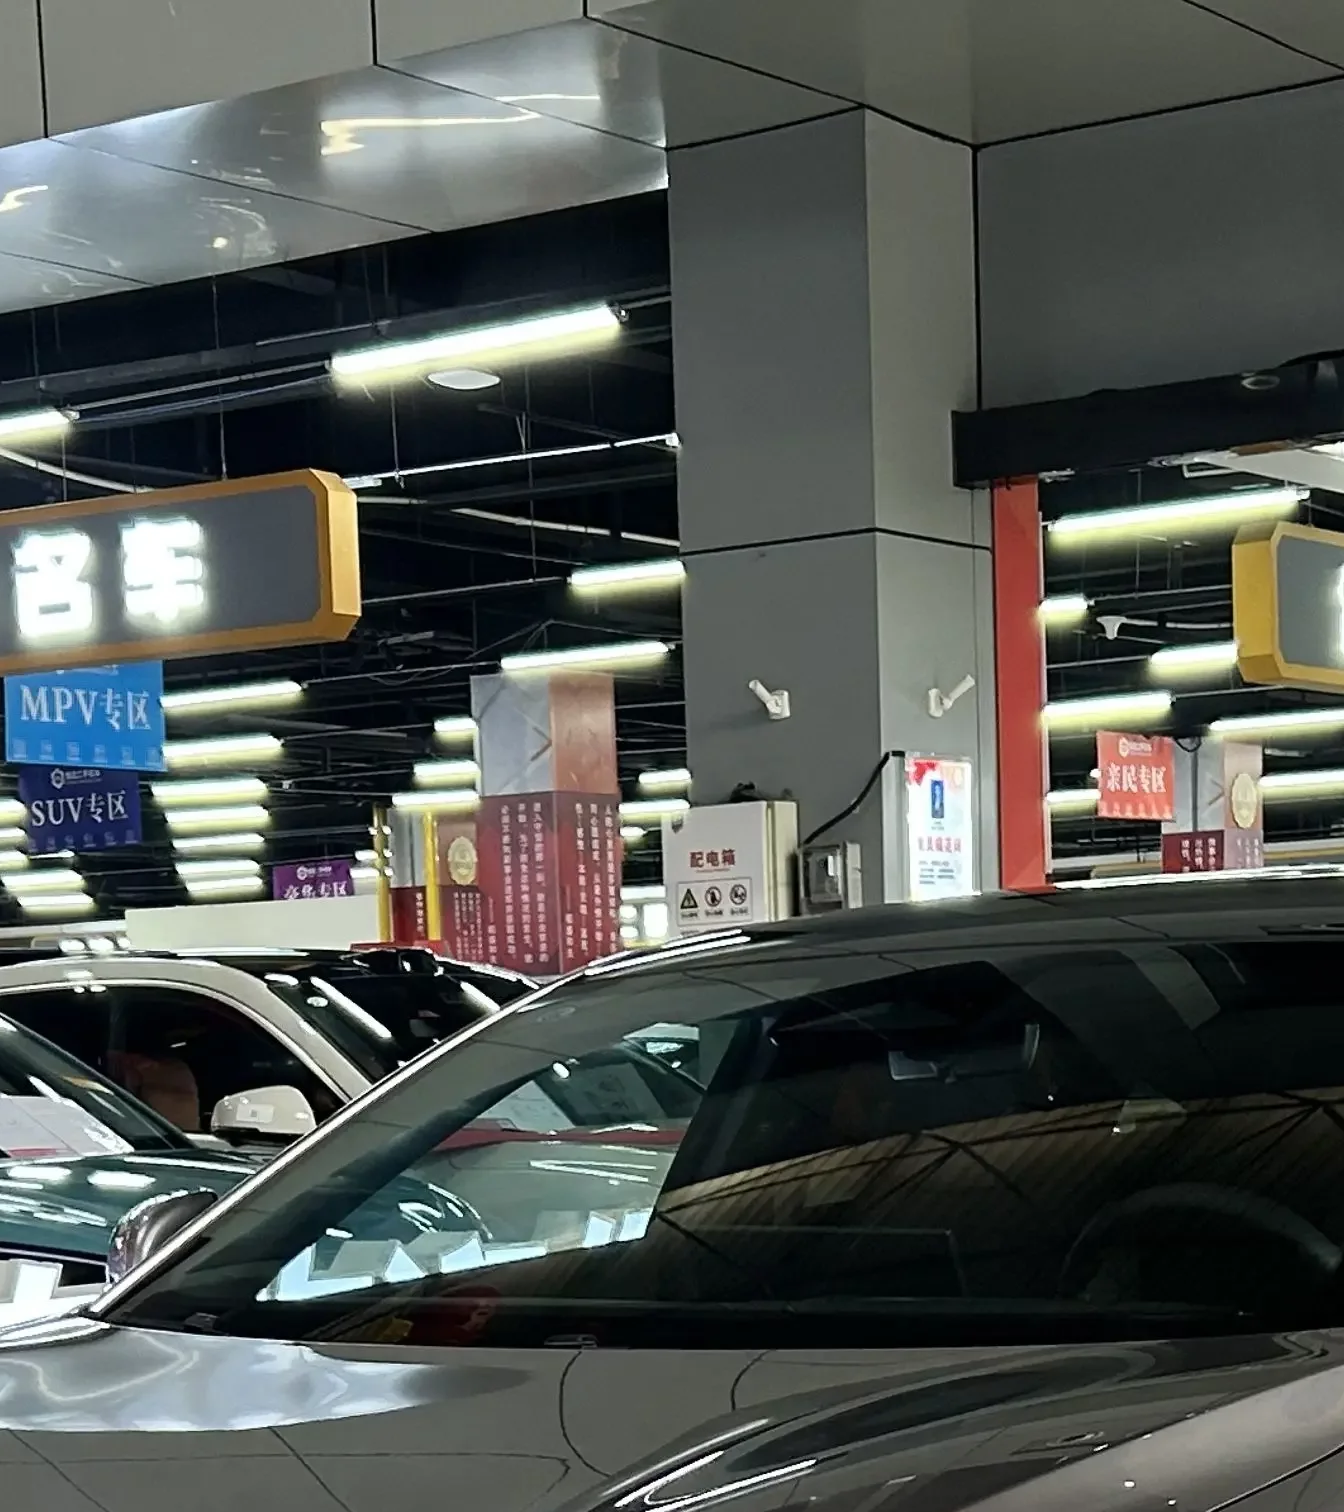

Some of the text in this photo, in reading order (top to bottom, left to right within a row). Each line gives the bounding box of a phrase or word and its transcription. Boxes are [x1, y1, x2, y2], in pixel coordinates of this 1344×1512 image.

[19, 683, 152, 732] MPV专区
[30, 789, 130, 828] SUV专区
[689, 848, 736, 869] 配电箱
